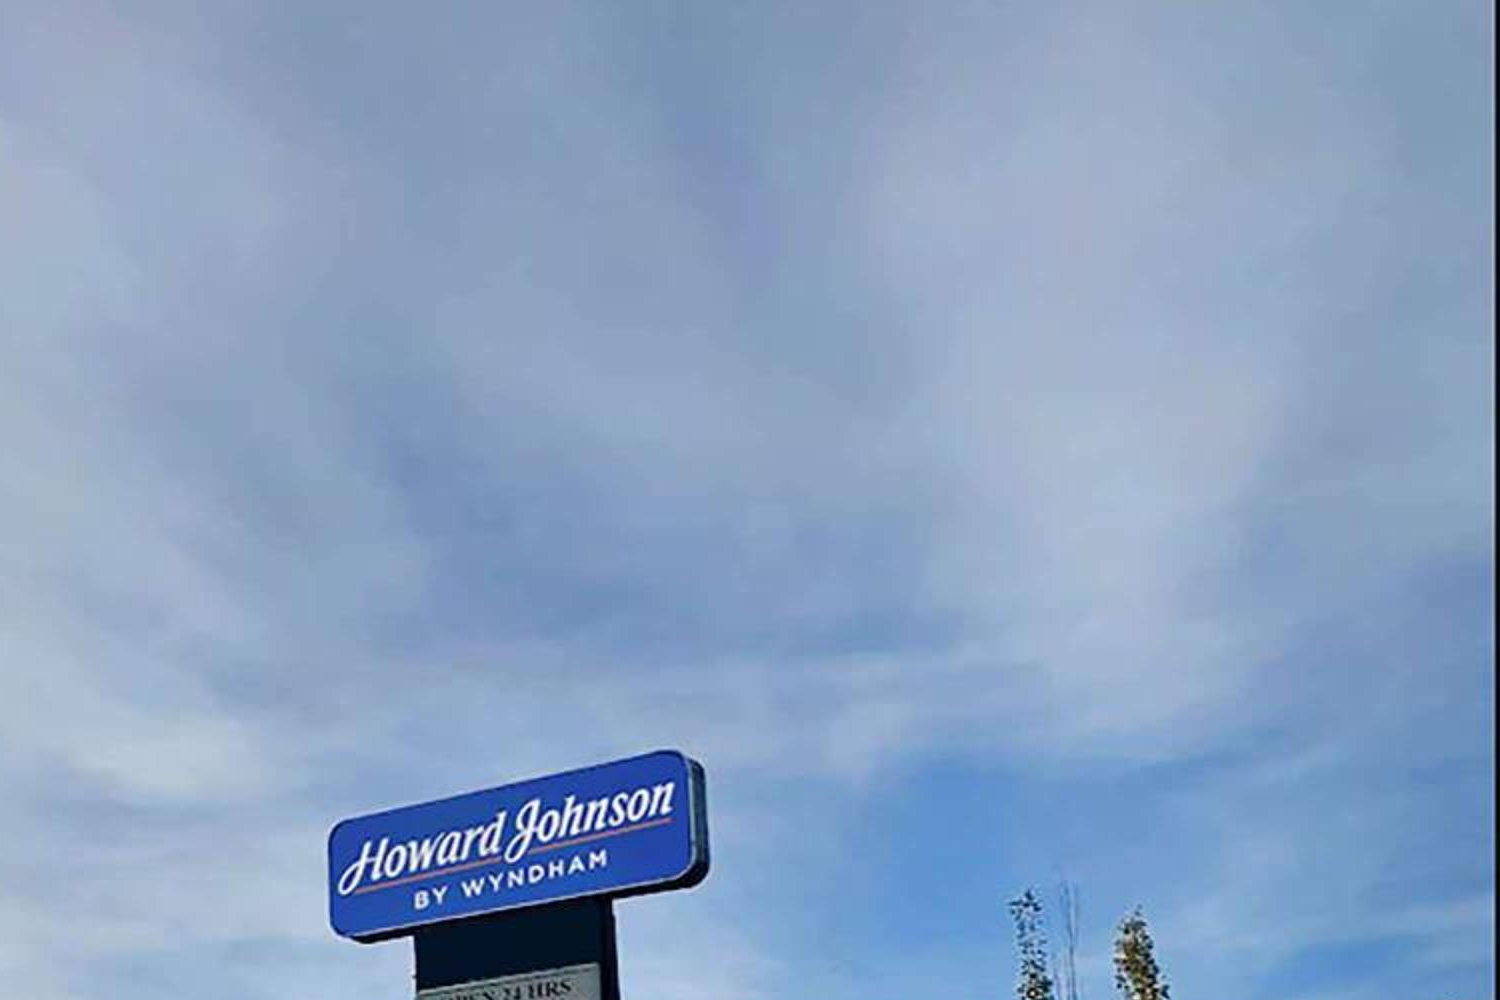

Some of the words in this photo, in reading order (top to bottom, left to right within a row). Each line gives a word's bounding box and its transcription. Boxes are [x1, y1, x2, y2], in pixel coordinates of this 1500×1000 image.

[338, 811, 506, 895] Howard
[505, 781, 674, 863] Johnson
[414, 886, 447, 910] BY
[461, 849, 607, 898] WYNDHAM
[528, 980, 572, 999] HRS
